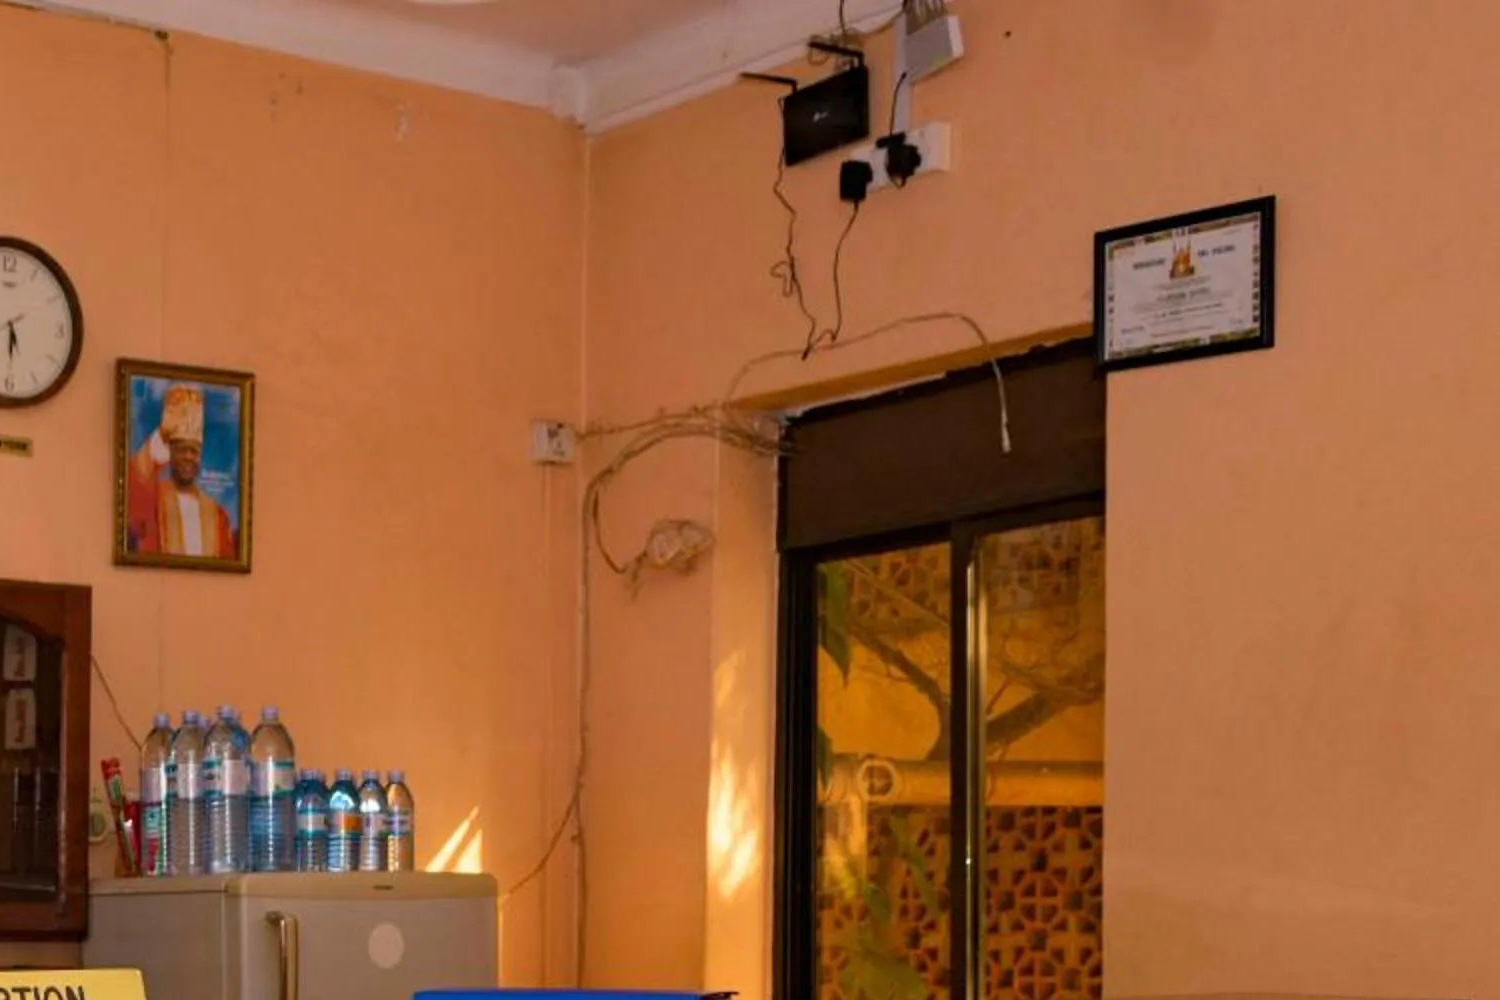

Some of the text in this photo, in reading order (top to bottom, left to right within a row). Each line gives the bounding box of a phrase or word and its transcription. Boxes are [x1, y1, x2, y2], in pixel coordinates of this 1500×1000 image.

[1, 253, 19, 273] 12
[54, 322, 66, 340] 3
[2, 375, 16, 393] 6
